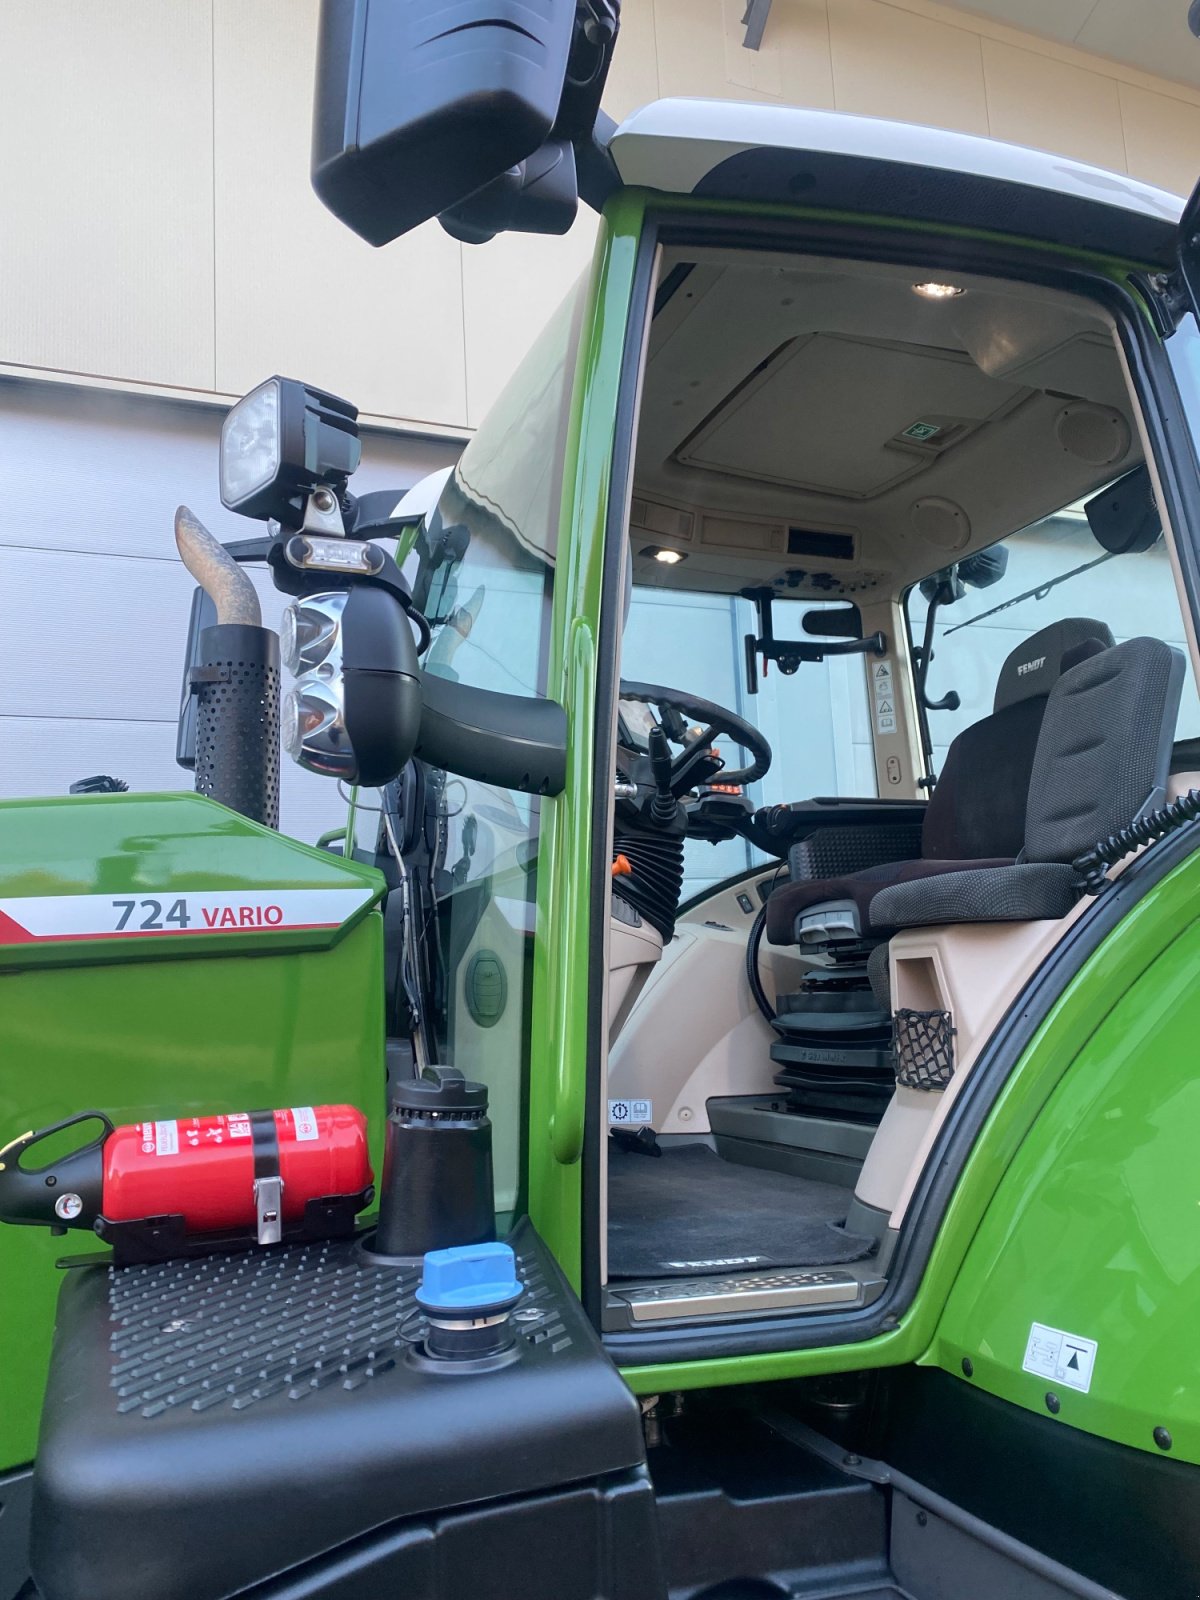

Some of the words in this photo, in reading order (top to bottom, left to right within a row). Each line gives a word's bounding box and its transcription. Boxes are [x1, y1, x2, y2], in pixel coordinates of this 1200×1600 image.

[1017, 656, 1046, 676] FENDT
[112, 899, 191, 930] 724
[201, 905, 283, 927] VARIO
